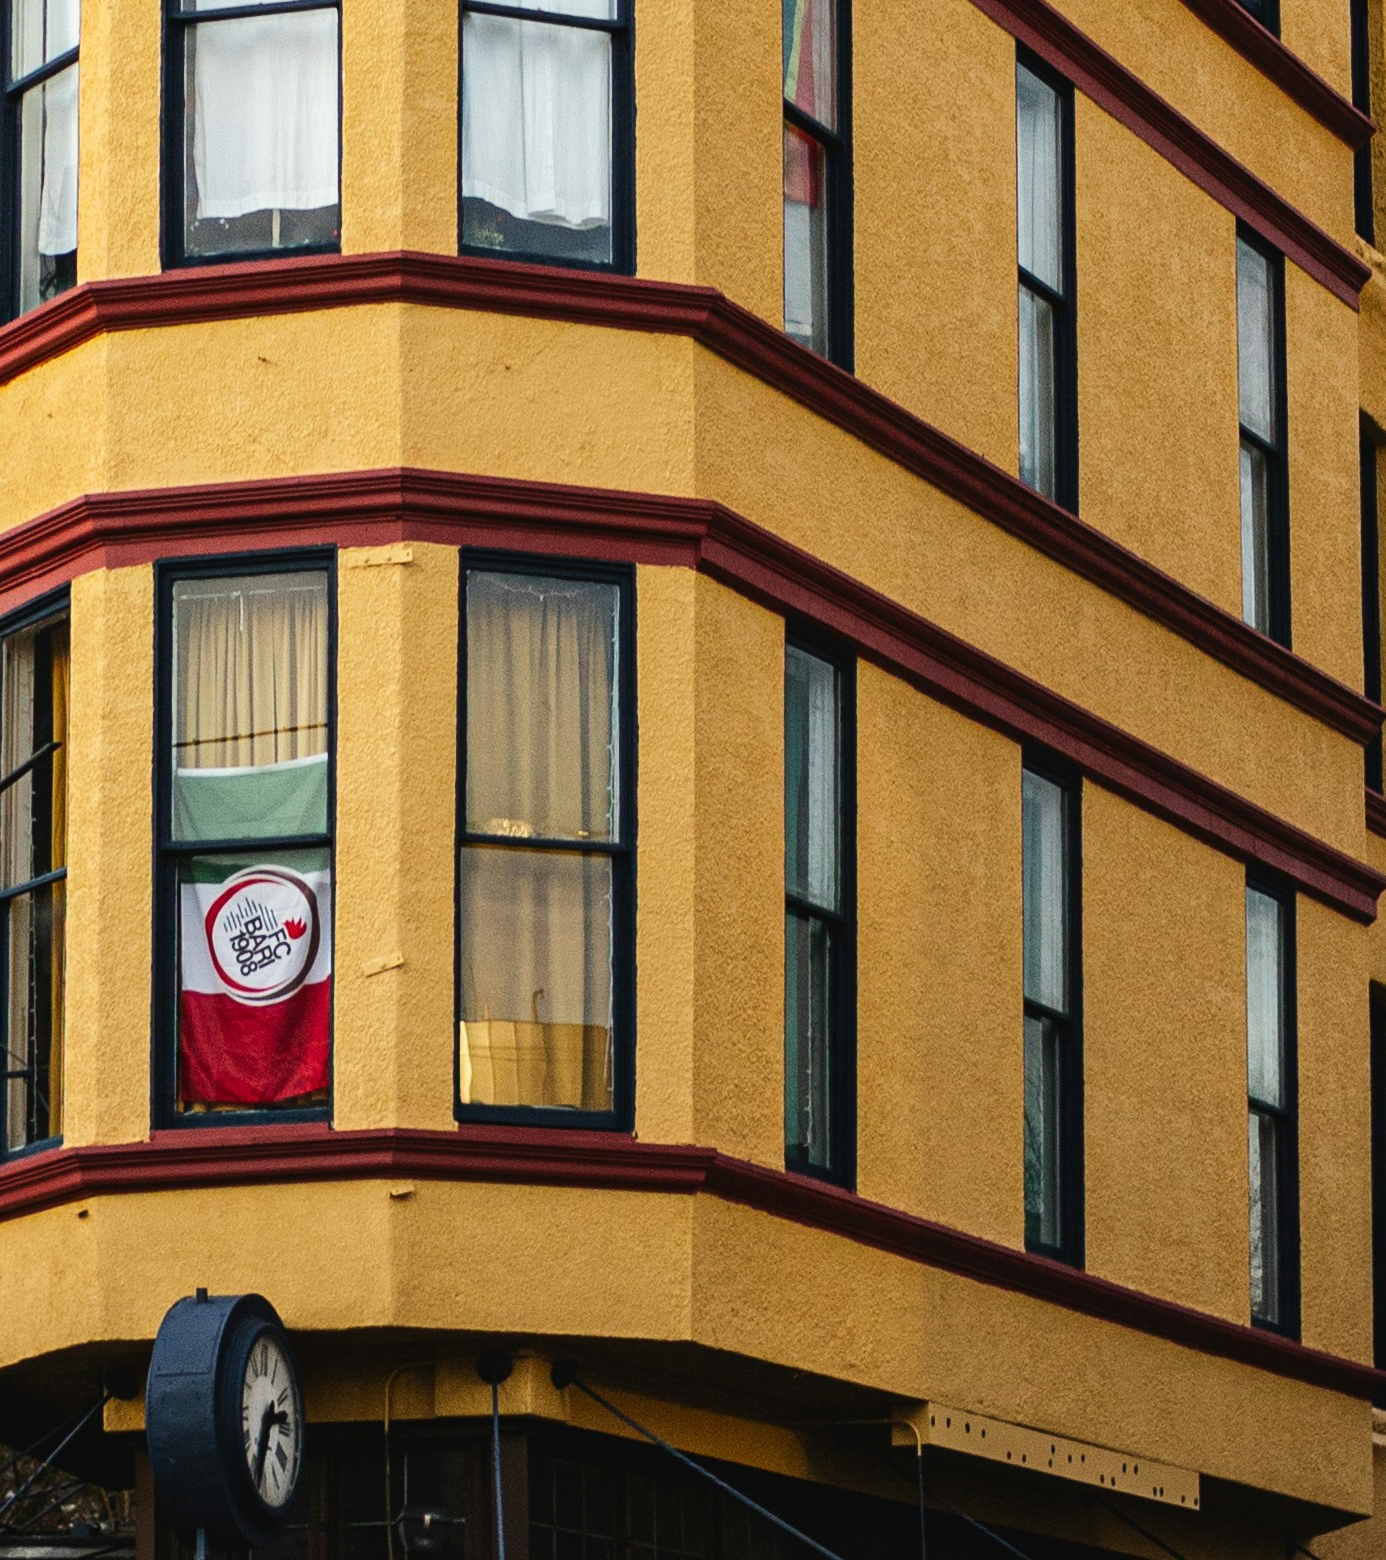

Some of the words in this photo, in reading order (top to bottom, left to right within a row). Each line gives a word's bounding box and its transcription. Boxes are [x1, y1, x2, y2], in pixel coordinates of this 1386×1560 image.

[229, 930, 258, 977] 1908
[244, 915, 275, 969] BARI
[267, 928, 292, 960] FC
